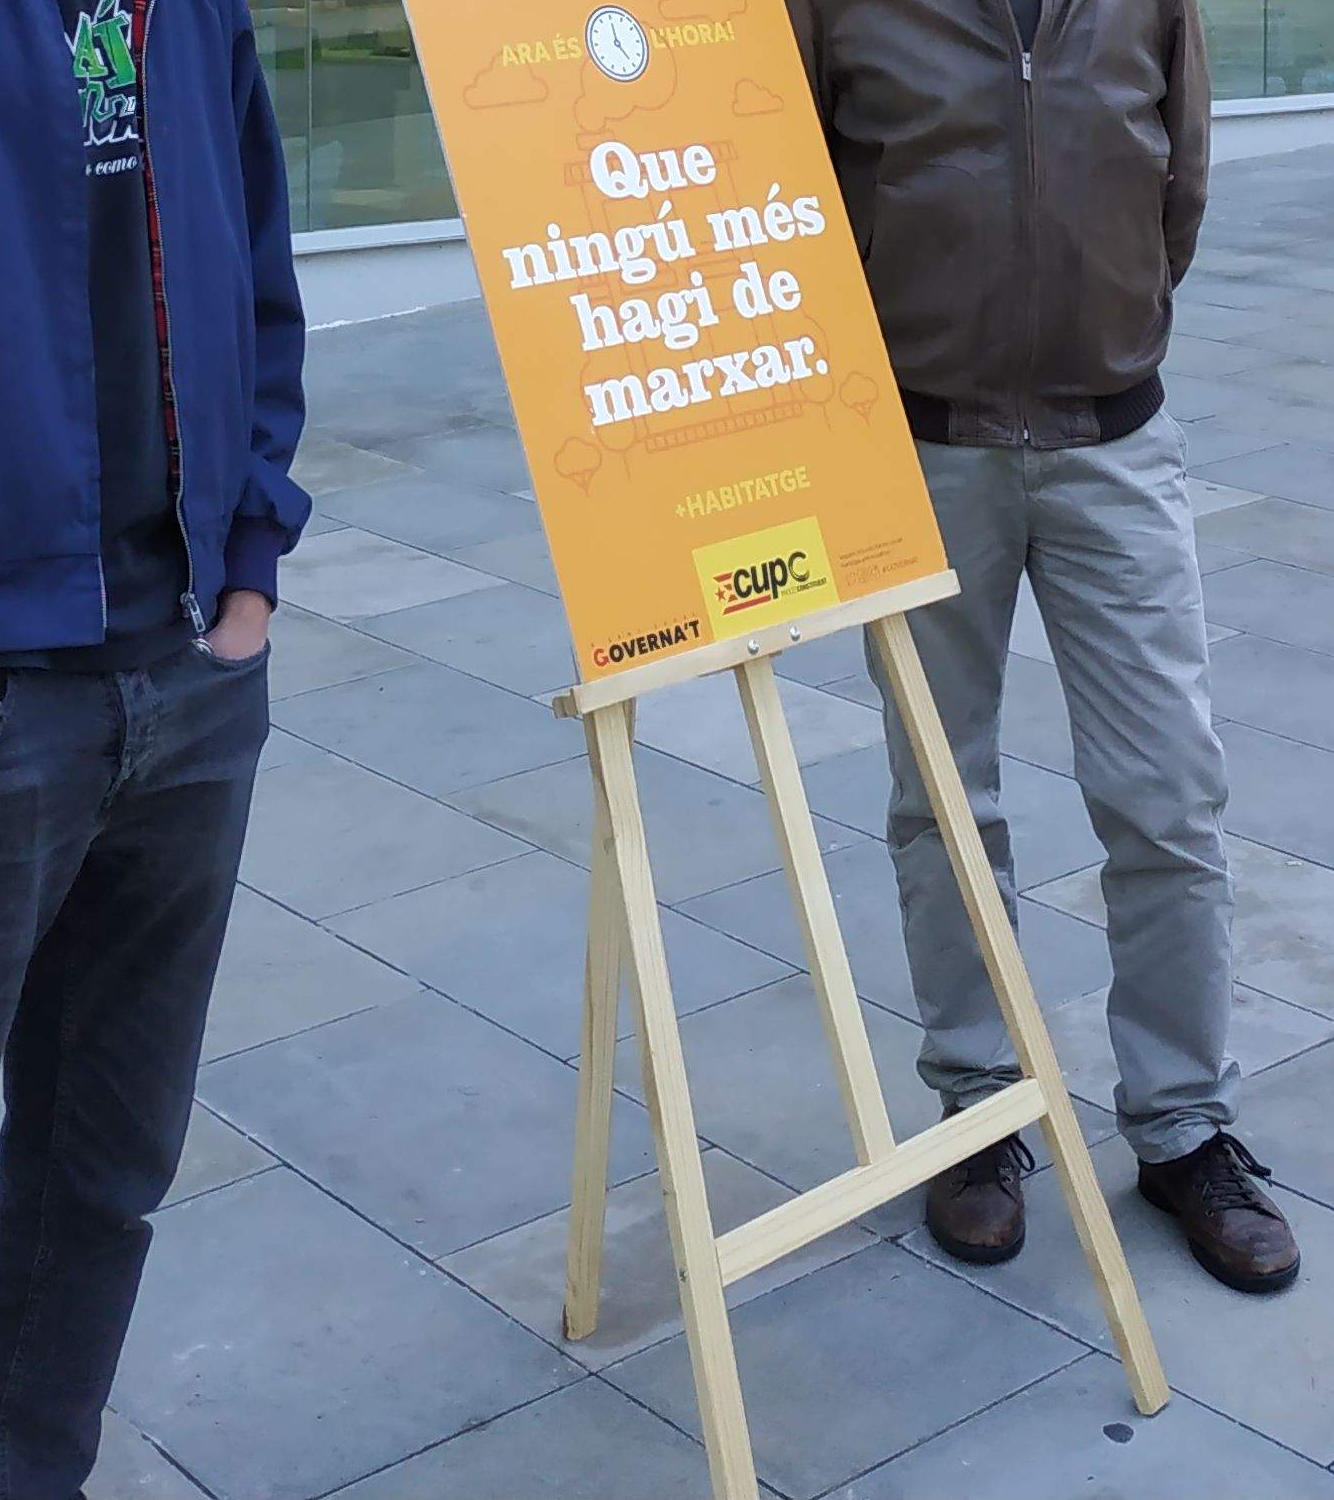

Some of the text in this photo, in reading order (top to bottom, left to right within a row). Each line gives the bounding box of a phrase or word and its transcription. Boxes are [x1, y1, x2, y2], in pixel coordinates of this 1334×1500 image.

[502, 19, 736, 67] ARA ÉS L'HORA!
[589, 140, 717, 200] Que
[502, 182, 826, 290] ningú més
[570, 261, 802, 352] hagi de
[584, 336, 829, 427] marxar.
[675, 465, 811, 518] +HABITATGE
[593, 619, 700, 668] GOVERNA'T
